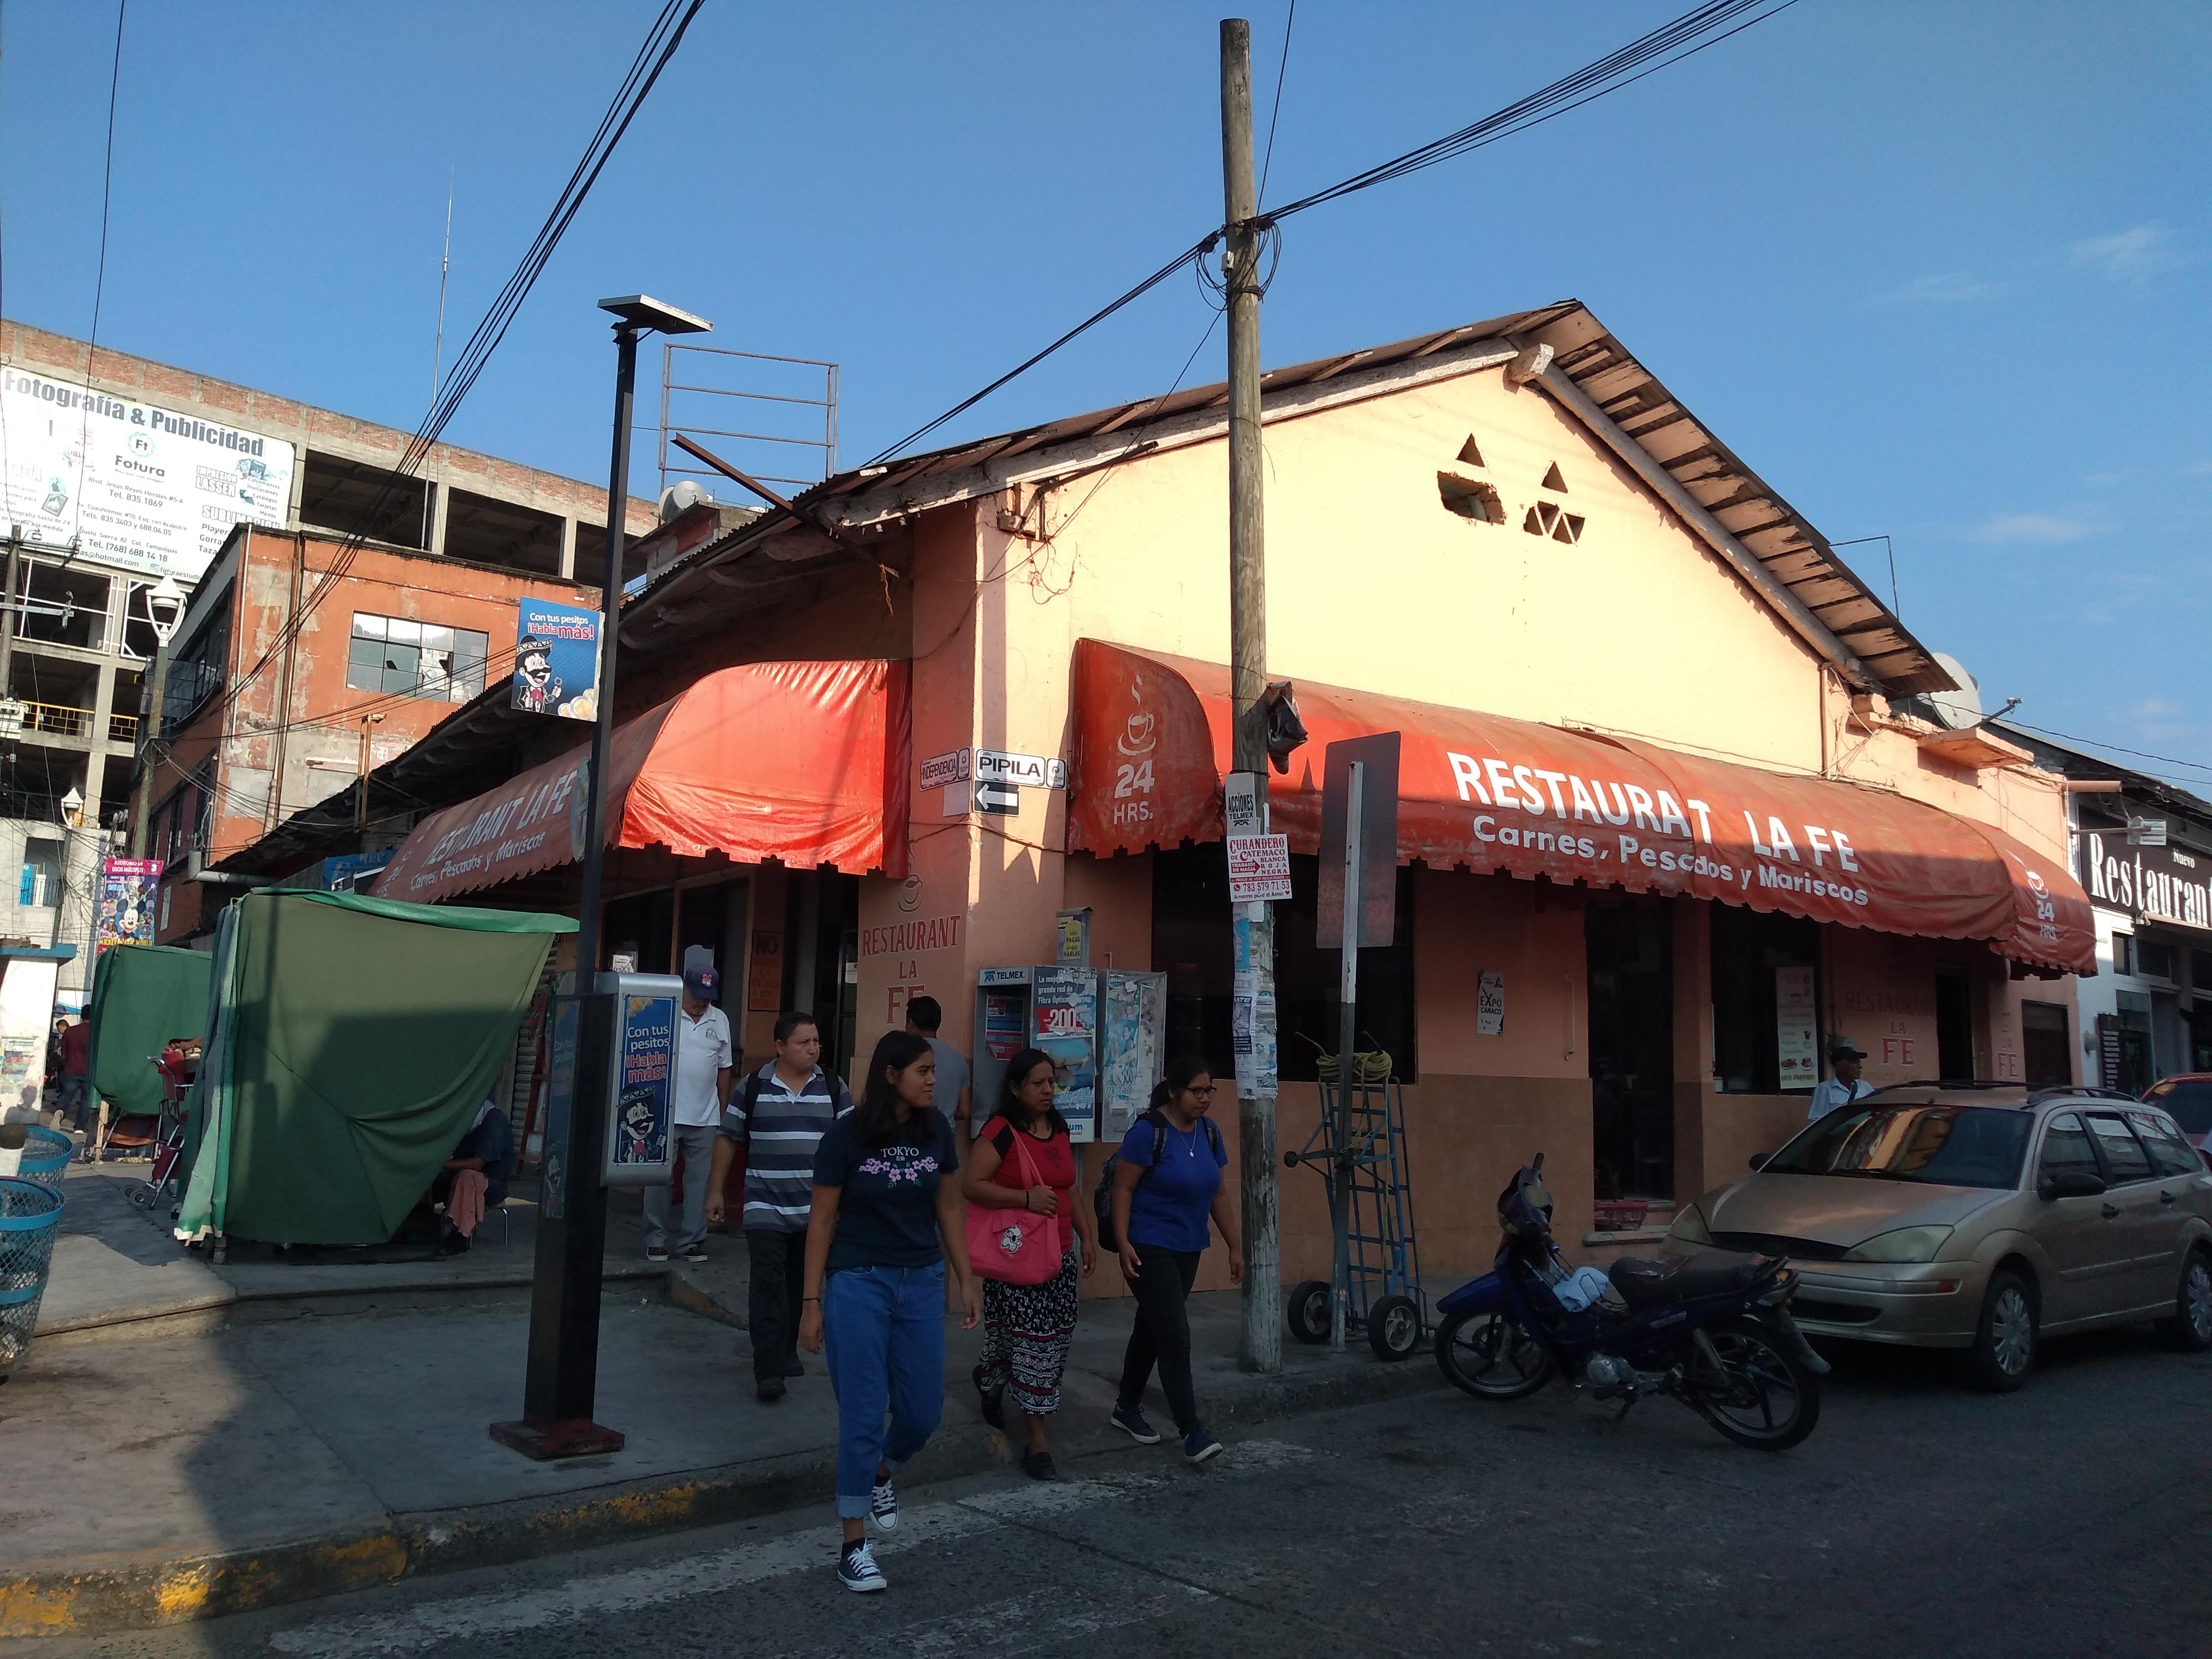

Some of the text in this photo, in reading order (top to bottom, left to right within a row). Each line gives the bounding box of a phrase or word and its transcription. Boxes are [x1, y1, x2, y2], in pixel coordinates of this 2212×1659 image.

[5, 370, 264, 457] Fotografía & Publicidad
[136, 439, 148, 451] Ft
[115, 455, 165, 477] Fotura
[197, 465, 237, 484] IMPRESION
[124, 485, 143, 494] Reyes
[145, 490, 167, 500] Heroles
[195, 475, 236, 497] LASSER
[247, 484, 278, 496] Invitaciones
[257, 501, 276, 511] Tarjetas
[139, 524, 172, 536] 688.04.05
[202, 523, 231, 535] Player
[99, 532, 118, 541] Sierra
[146, 543, 178, 554] Tamaulipas
[106, 542, 127, 554] (768)
[129, 548, 144, 557] 688
[147, 551, 155, 560] 14
[159, 554, 168, 563] 18
[530, 613, 546, 622] Con
[561, 615, 589, 625] pesitos
[527, 623, 594, 641] ¡Habla más!
[922, 758, 956, 781] INDEPENDENCIA
[979, 757, 1041, 777] PIPILA
[1114, 760, 1155, 799] 24
[1113, 801, 1153, 825] HRS.
[1229, 811, 1254, 820] TELMEX
[495, 831, 546, 862] Mariscos
[1229, 837, 1285, 854] CURANDERO
[1743, 810, 1858, 872] LA FE
[1239, 849, 1285, 861] CATEMACO
[2173, 848, 2196, 868] Nuevo
[151, 864, 157, 872] 3
[1243, 881, 1289, 892] 783 579 71 53
[1740, 868, 1752, 891] y
[1758, 864, 1869, 906] Mariscos
[2037, 900, 2055, 921] 24
[861, 914, 961, 957] RESTAURANT
[898, 959, 918, 980] LA
[996, 971, 1024, 980] TELMEX
[1038, 986, 1055, 995] grande
[1052, 994, 1068, 1005] Óptica
[1480, 987, 1502, 1008] EXPO
[1050, 1008, 1077, 1029] 200
[1480, 1007, 1502, 1015] CANACO
[627, 1025, 668, 1038] Con tus
[1890, 1020, 1906, 1035] LA
[631, 1037, 669, 1053] pesitos
[1880, 1037, 1915, 1066] FE
[626, 1051, 667, 1068] ¡Habla
[1997, 1053, 2018, 1077] FE
[628, 1063, 667, 1084] más!
[881, 1146, 919, 1158] TOKYO
